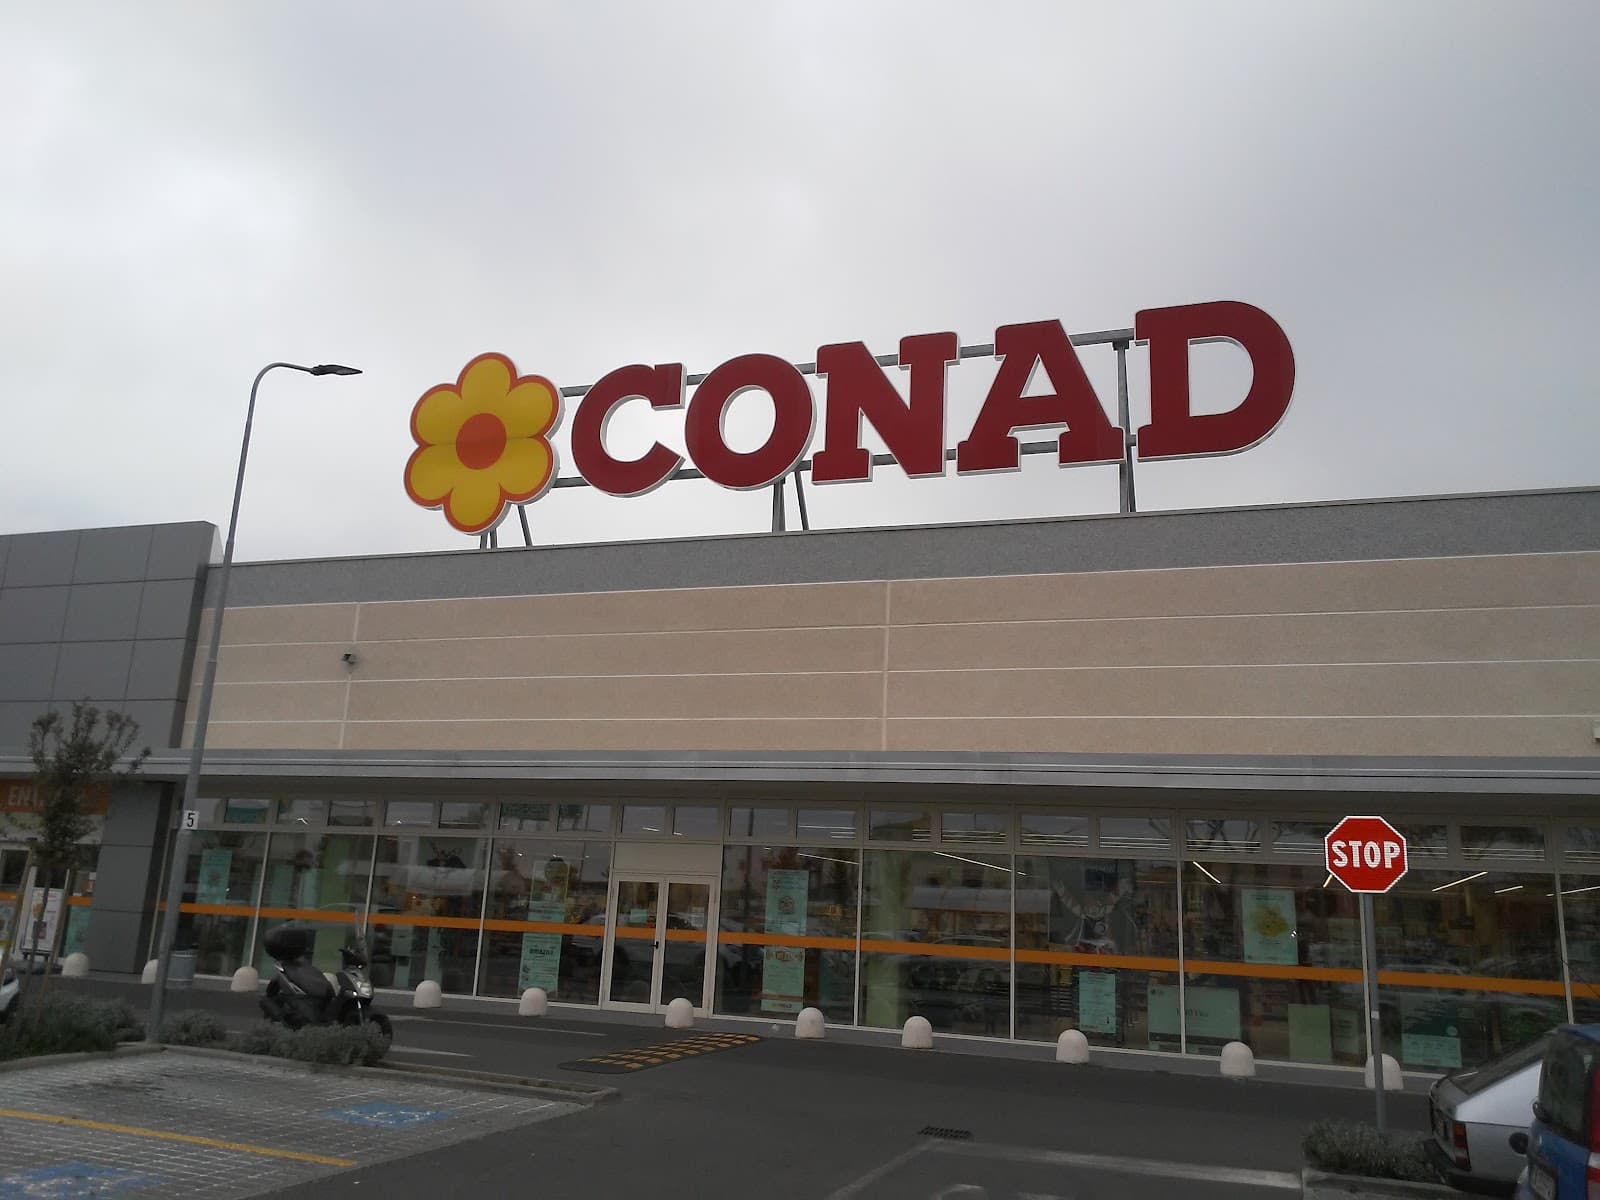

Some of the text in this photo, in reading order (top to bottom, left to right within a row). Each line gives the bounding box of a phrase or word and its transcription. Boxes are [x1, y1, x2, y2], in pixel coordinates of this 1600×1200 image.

[571, 301, 1295, 497] CONAD
[187, 812, 196, 828] 5
[1331, 840, 1400, 868] STOP
